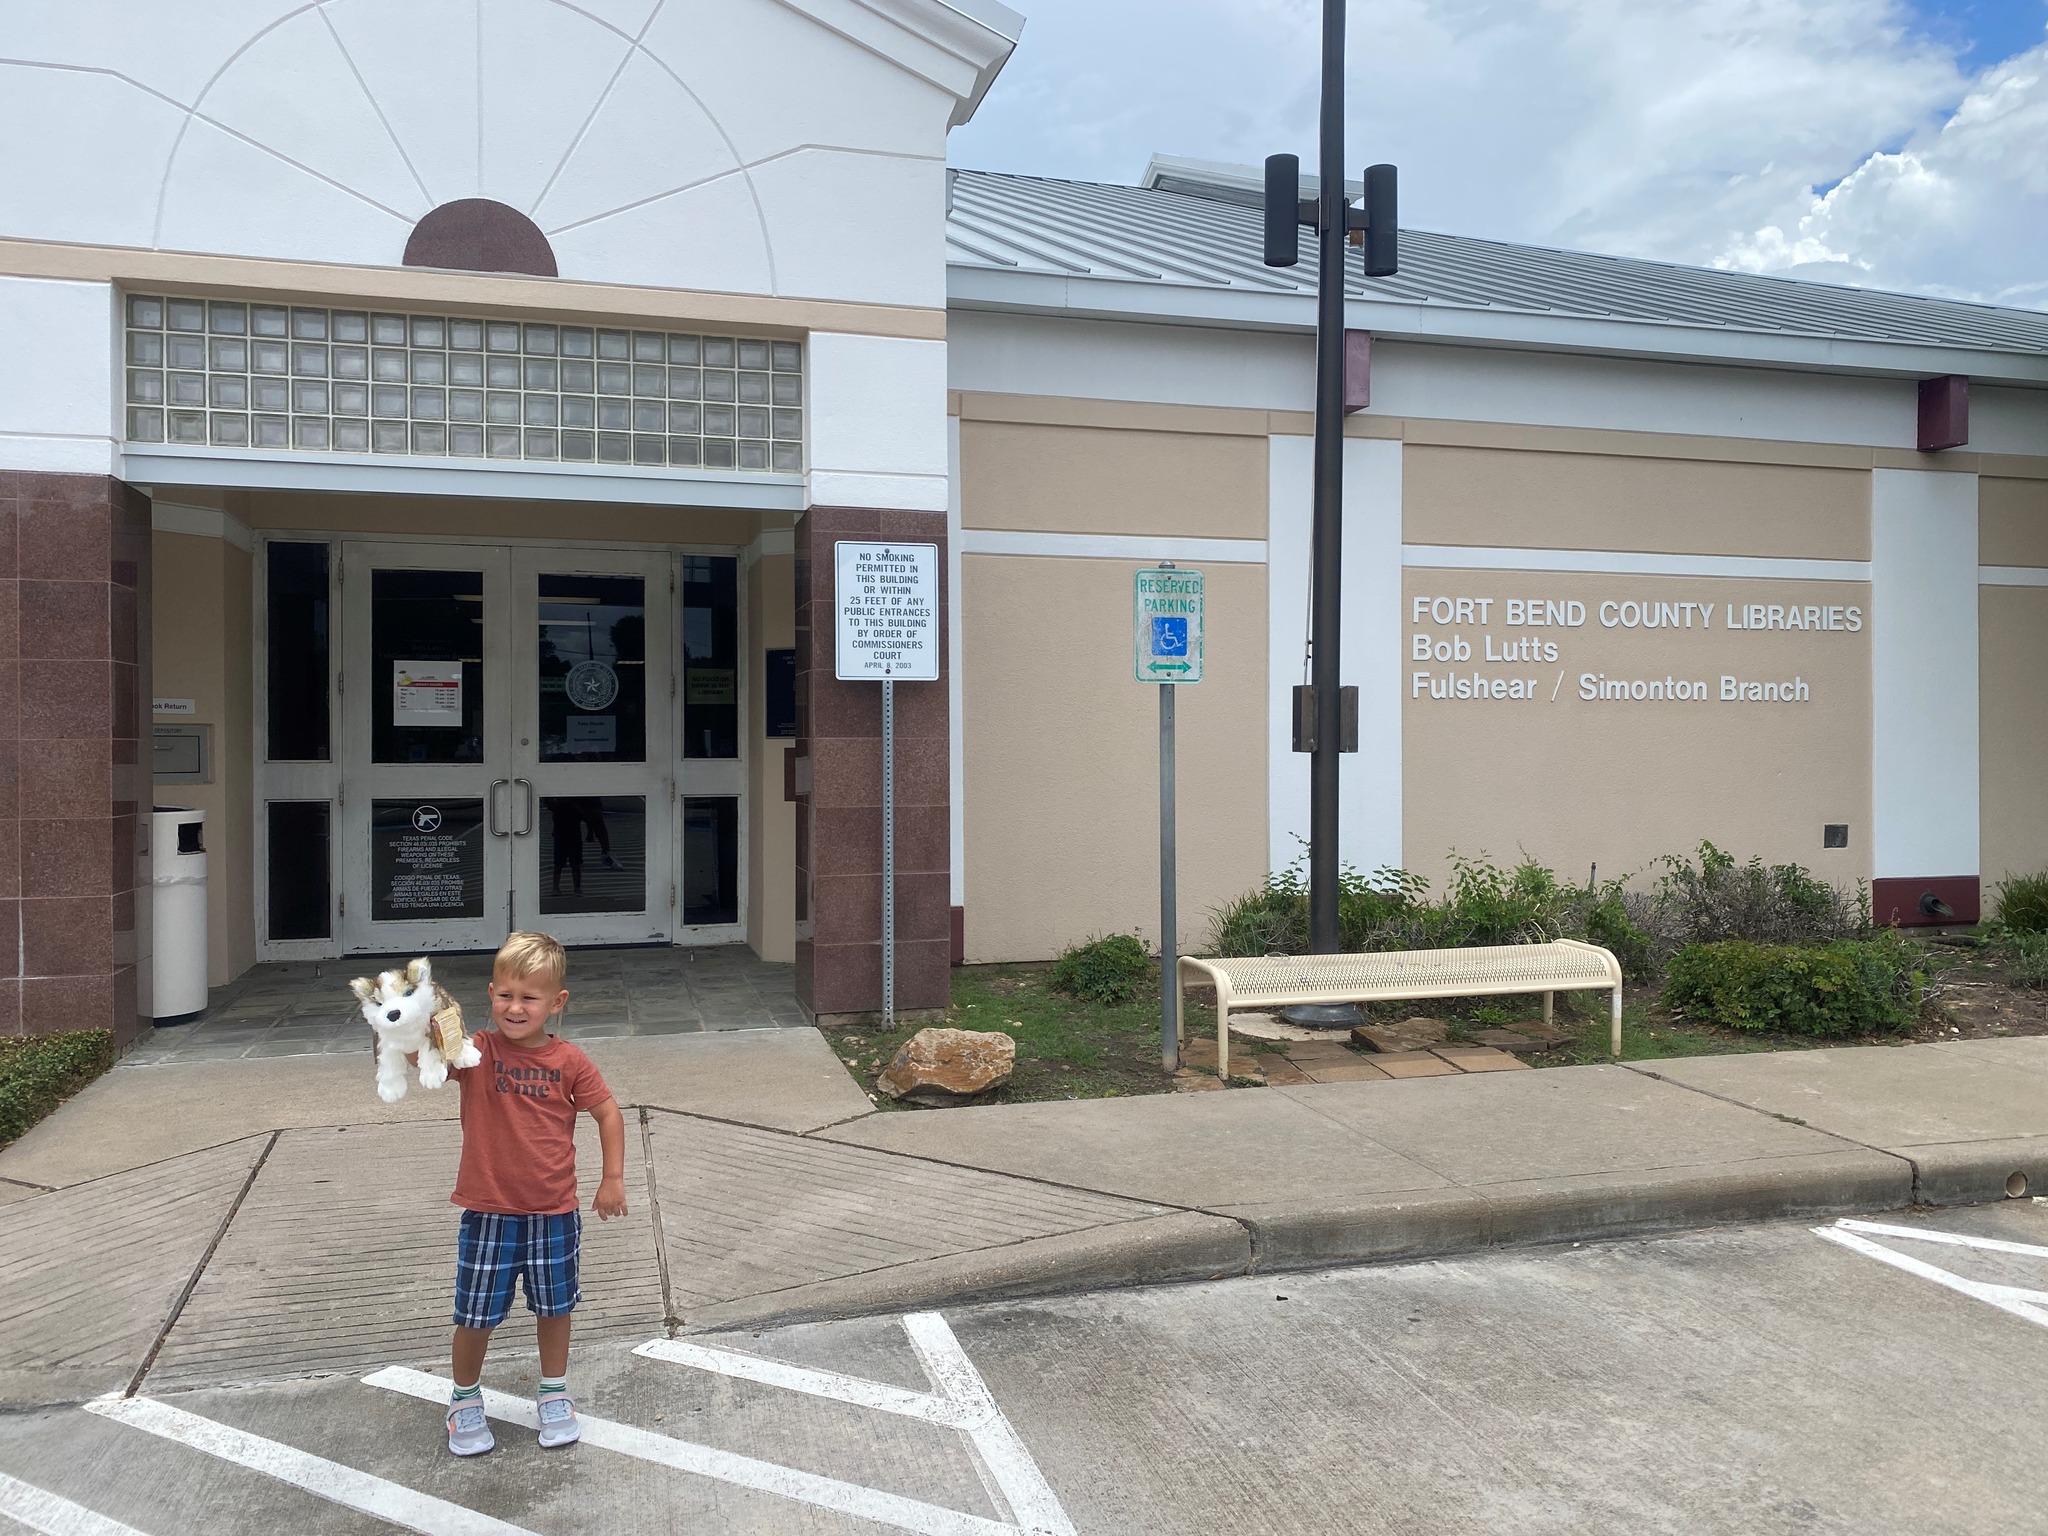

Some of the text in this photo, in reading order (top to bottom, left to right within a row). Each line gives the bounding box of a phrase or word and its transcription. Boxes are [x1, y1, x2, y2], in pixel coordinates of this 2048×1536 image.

[876, 553, 914, 562] SMOKING
[856, 564, 905, 572] PERMITTED
[880, 576, 918, 584] BUILDING
[1140, 580, 1198, 594] RESERVED
[850, 596, 860, 604] 25
[891, 597, 902, 605] OF
[1145, 599, 1195, 613] PARKING
[845, 607, 930, 616] PUBLIC ENTRANCES
[1412, 596, 1863, 632] FORT BEND COUNTY LIBRARIES
[888, 619, 926, 627] BUILDING
[852, 640, 923, 649] COMMISSIONERS
[1412, 634, 1559, 662] Bob Lutts
[1412, 670, 1809, 702] Fulshear / Simonton Branch
[496, 1077, 550, 1098] & me
